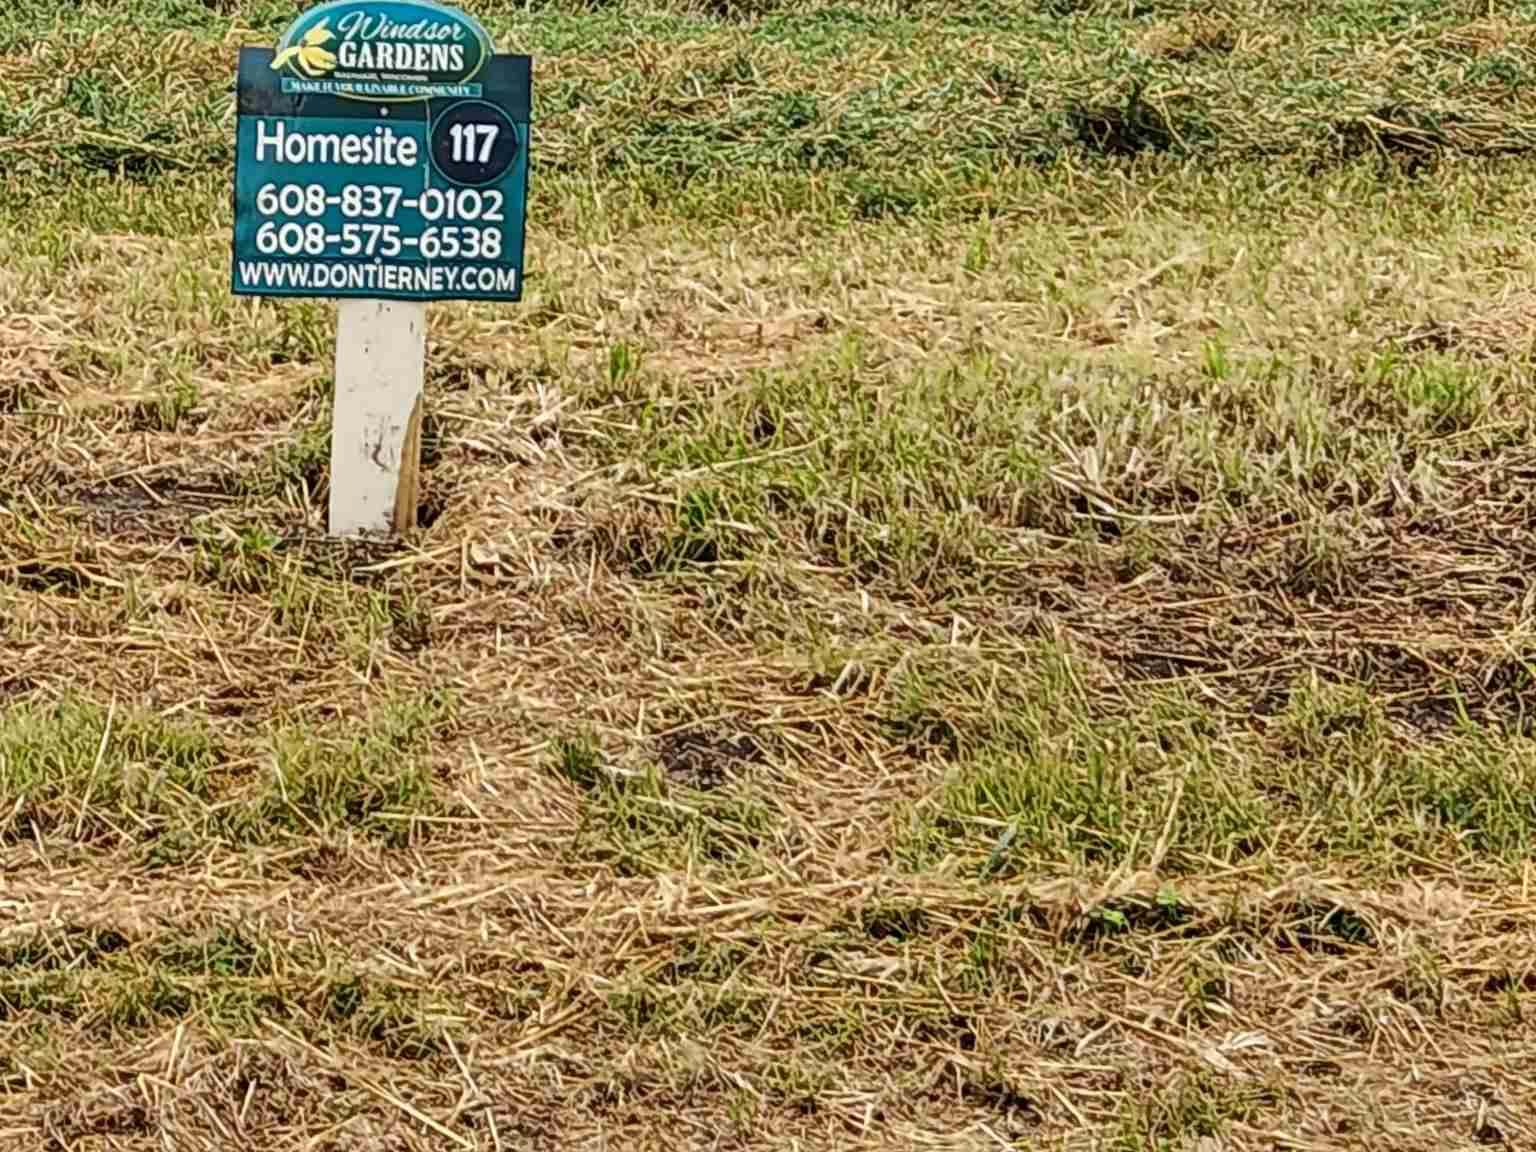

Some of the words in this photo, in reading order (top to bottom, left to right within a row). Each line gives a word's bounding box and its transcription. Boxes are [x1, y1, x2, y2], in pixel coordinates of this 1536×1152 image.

[337, 11, 465, 42] Windsor
[338, 42, 465, 72] GARDENS
[255, 119, 418, 167] Homesite
[449, 122, 500, 163] 117
[255, 183, 504, 222] 608-837-0102
[255, 220, 503, 259] 608-575-6538
[238, 260, 516, 292] WWW.DONTIERNEY.COM
